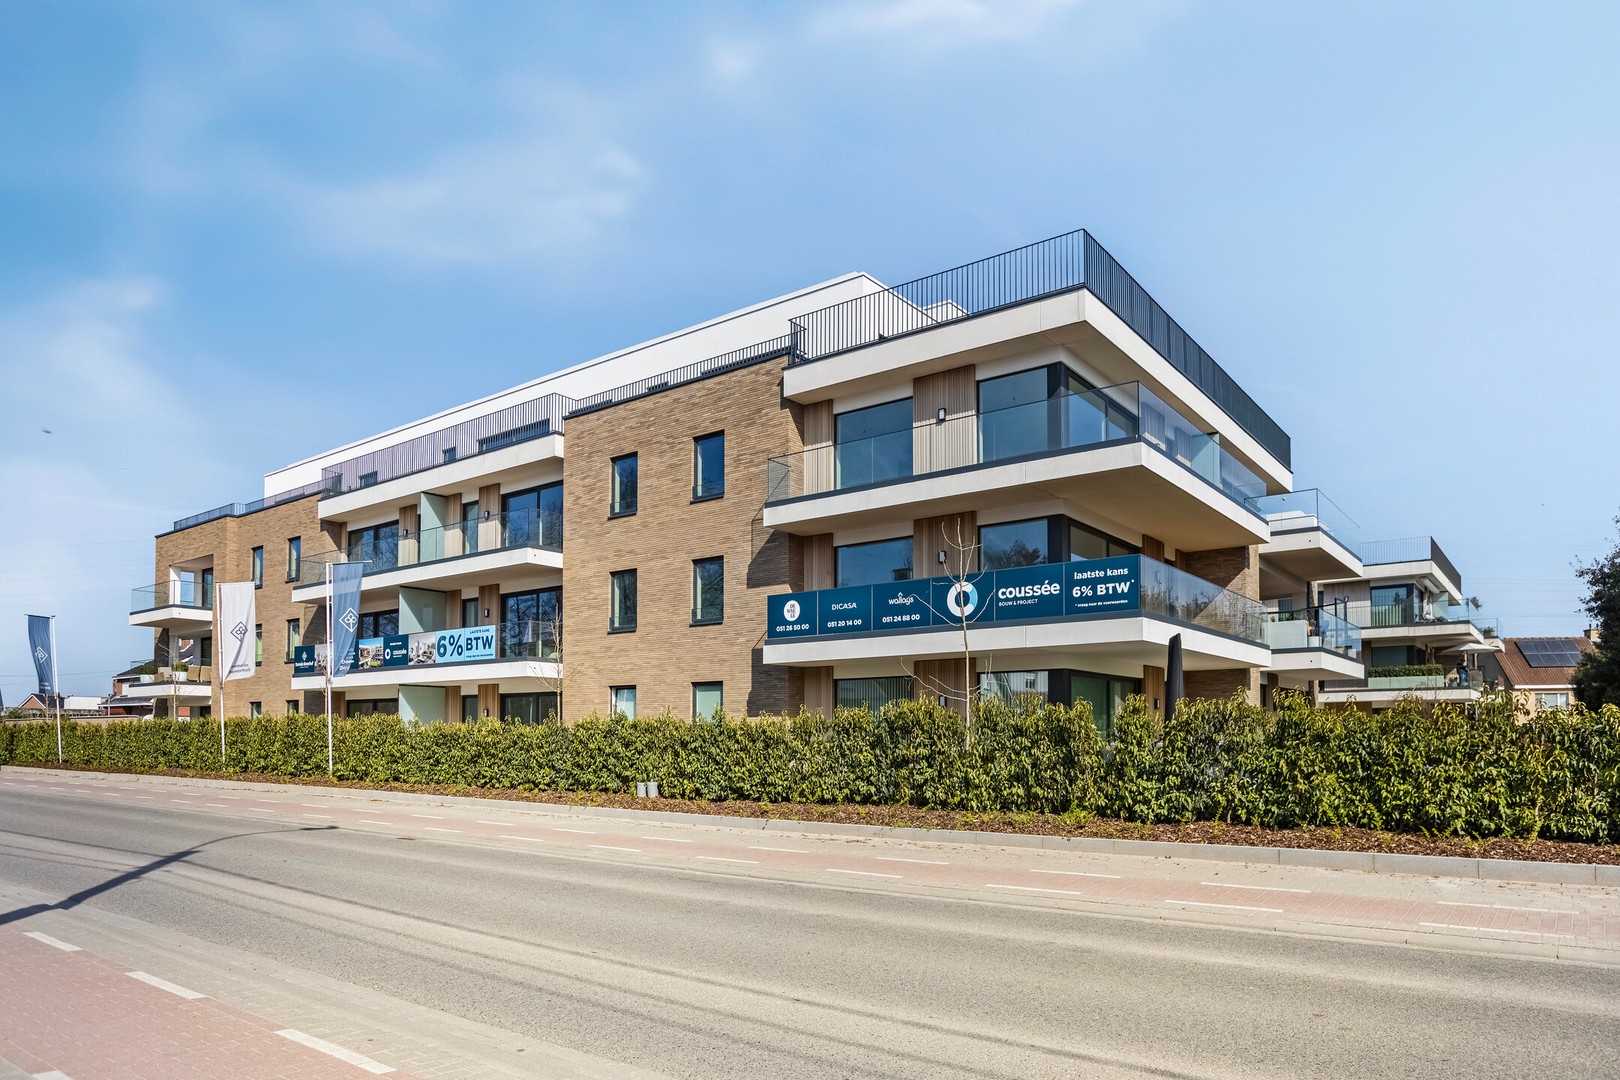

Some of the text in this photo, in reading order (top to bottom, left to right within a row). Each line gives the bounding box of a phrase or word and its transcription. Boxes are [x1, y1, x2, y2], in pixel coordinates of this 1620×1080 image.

[1074, 567, 1128, 579] laatste kans
[998, 579, 1059, 598] coussée
[1072, 585, 1092, 597] 6%
[831, 602, 857, 610] DICASA
[436, 634, 493, 657] 6% BTW
